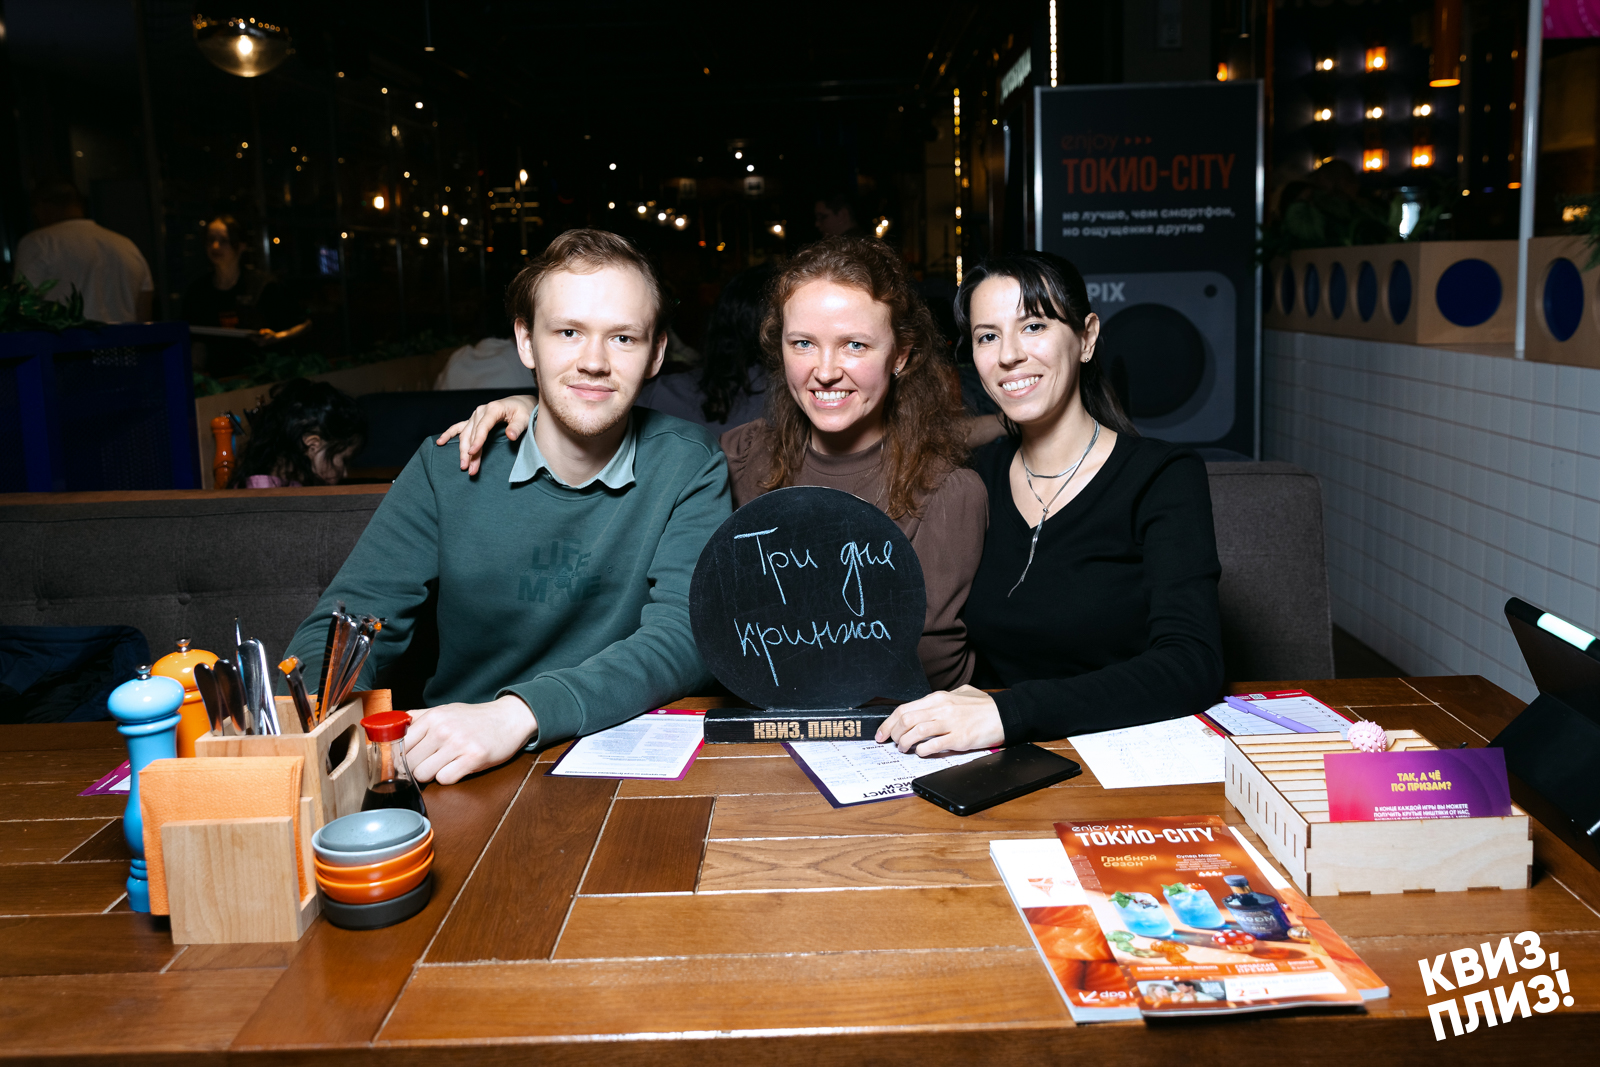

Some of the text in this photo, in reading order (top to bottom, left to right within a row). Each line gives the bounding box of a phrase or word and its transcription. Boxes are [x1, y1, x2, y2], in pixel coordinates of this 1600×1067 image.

[1061, 130, 1118, 154] enjoy
[1062, 205, 1236, 223] не лучше, чем смартфон,
[1082, 225, 1154, 239] ощущения
[1155, 223, 1205, 237] другие
[734, 526, 819, 605] Три
[753, 720, 862, 740] КВИЗ, ПЛИЗ!
[1397, 769, 1441, 782] ТАК, А ЧЁ
[1391, 781, 1452, 792] ПО ПРИЗАМ?
[1071, 824, 1109, 832] enjoy
[1074, 827, 1215, 847] ТОКИО-CITY
[1101, 854, 1157, 864] Грибной
